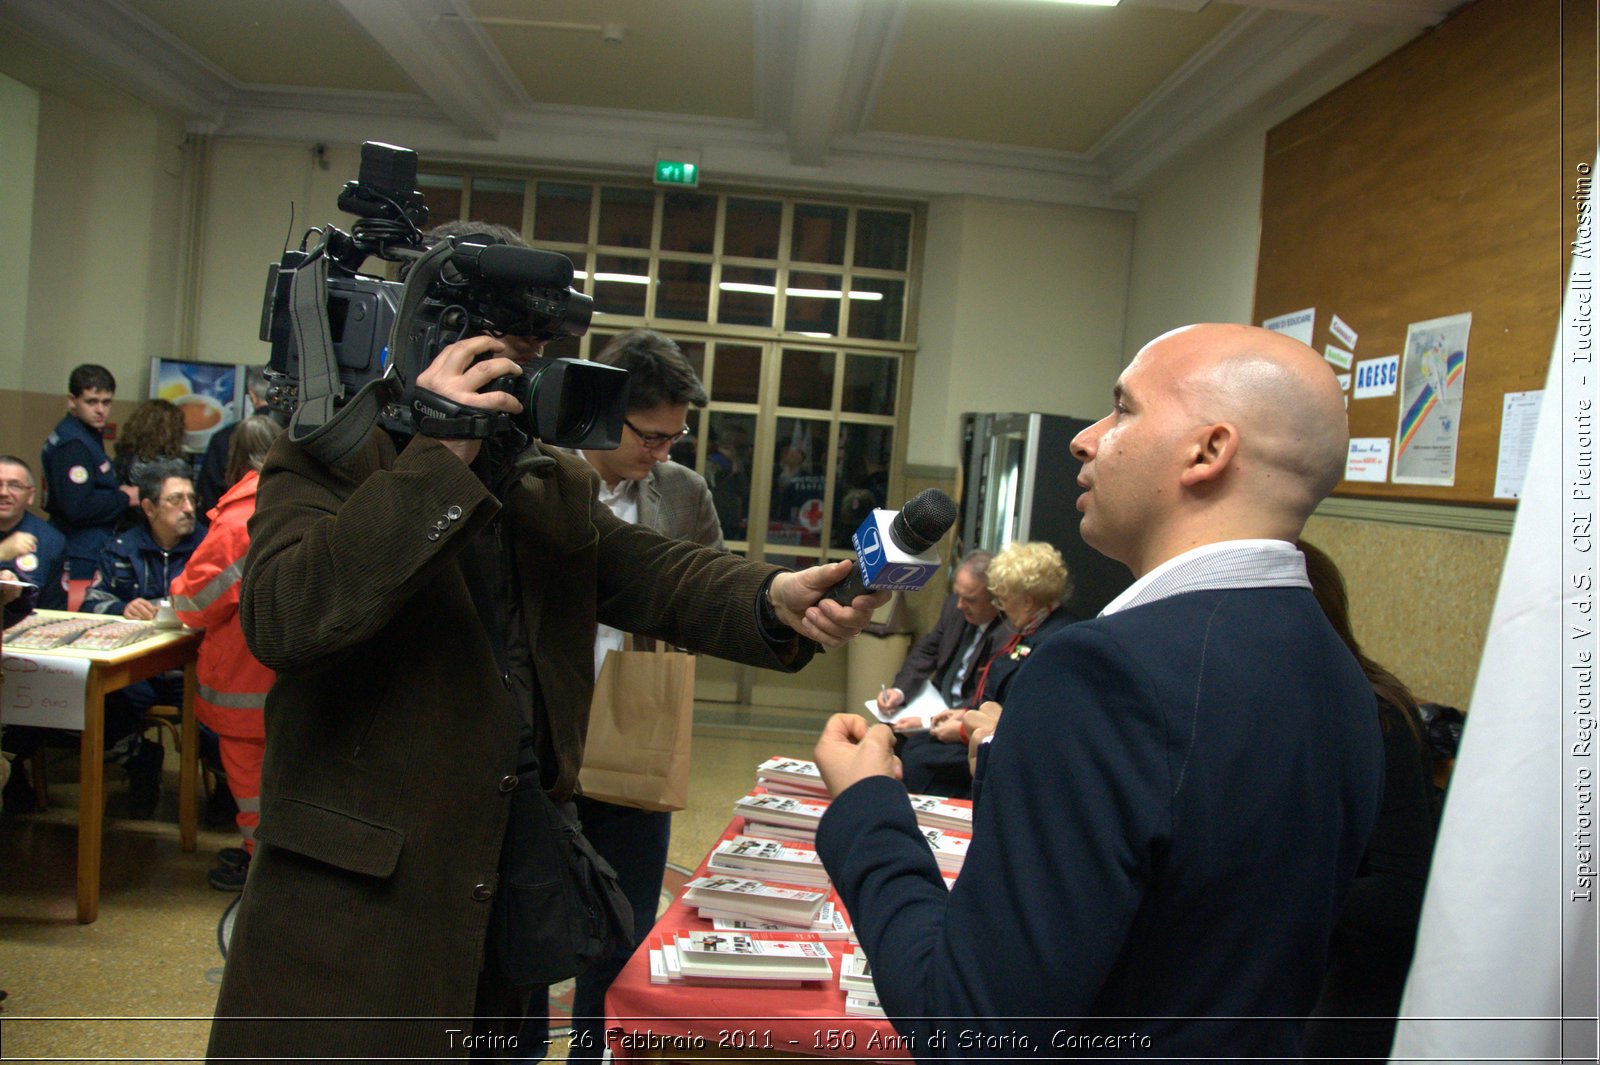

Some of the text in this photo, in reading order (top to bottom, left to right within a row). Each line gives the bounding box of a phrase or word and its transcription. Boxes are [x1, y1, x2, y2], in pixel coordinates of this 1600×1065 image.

[1357, 361, 1397, 389] AGESC
[414, 400, 447, 420] Canon
[863, 530, 881, 556] 7
[895, 566, 921, 584] 7
[13, 685, 33, 709] 5
